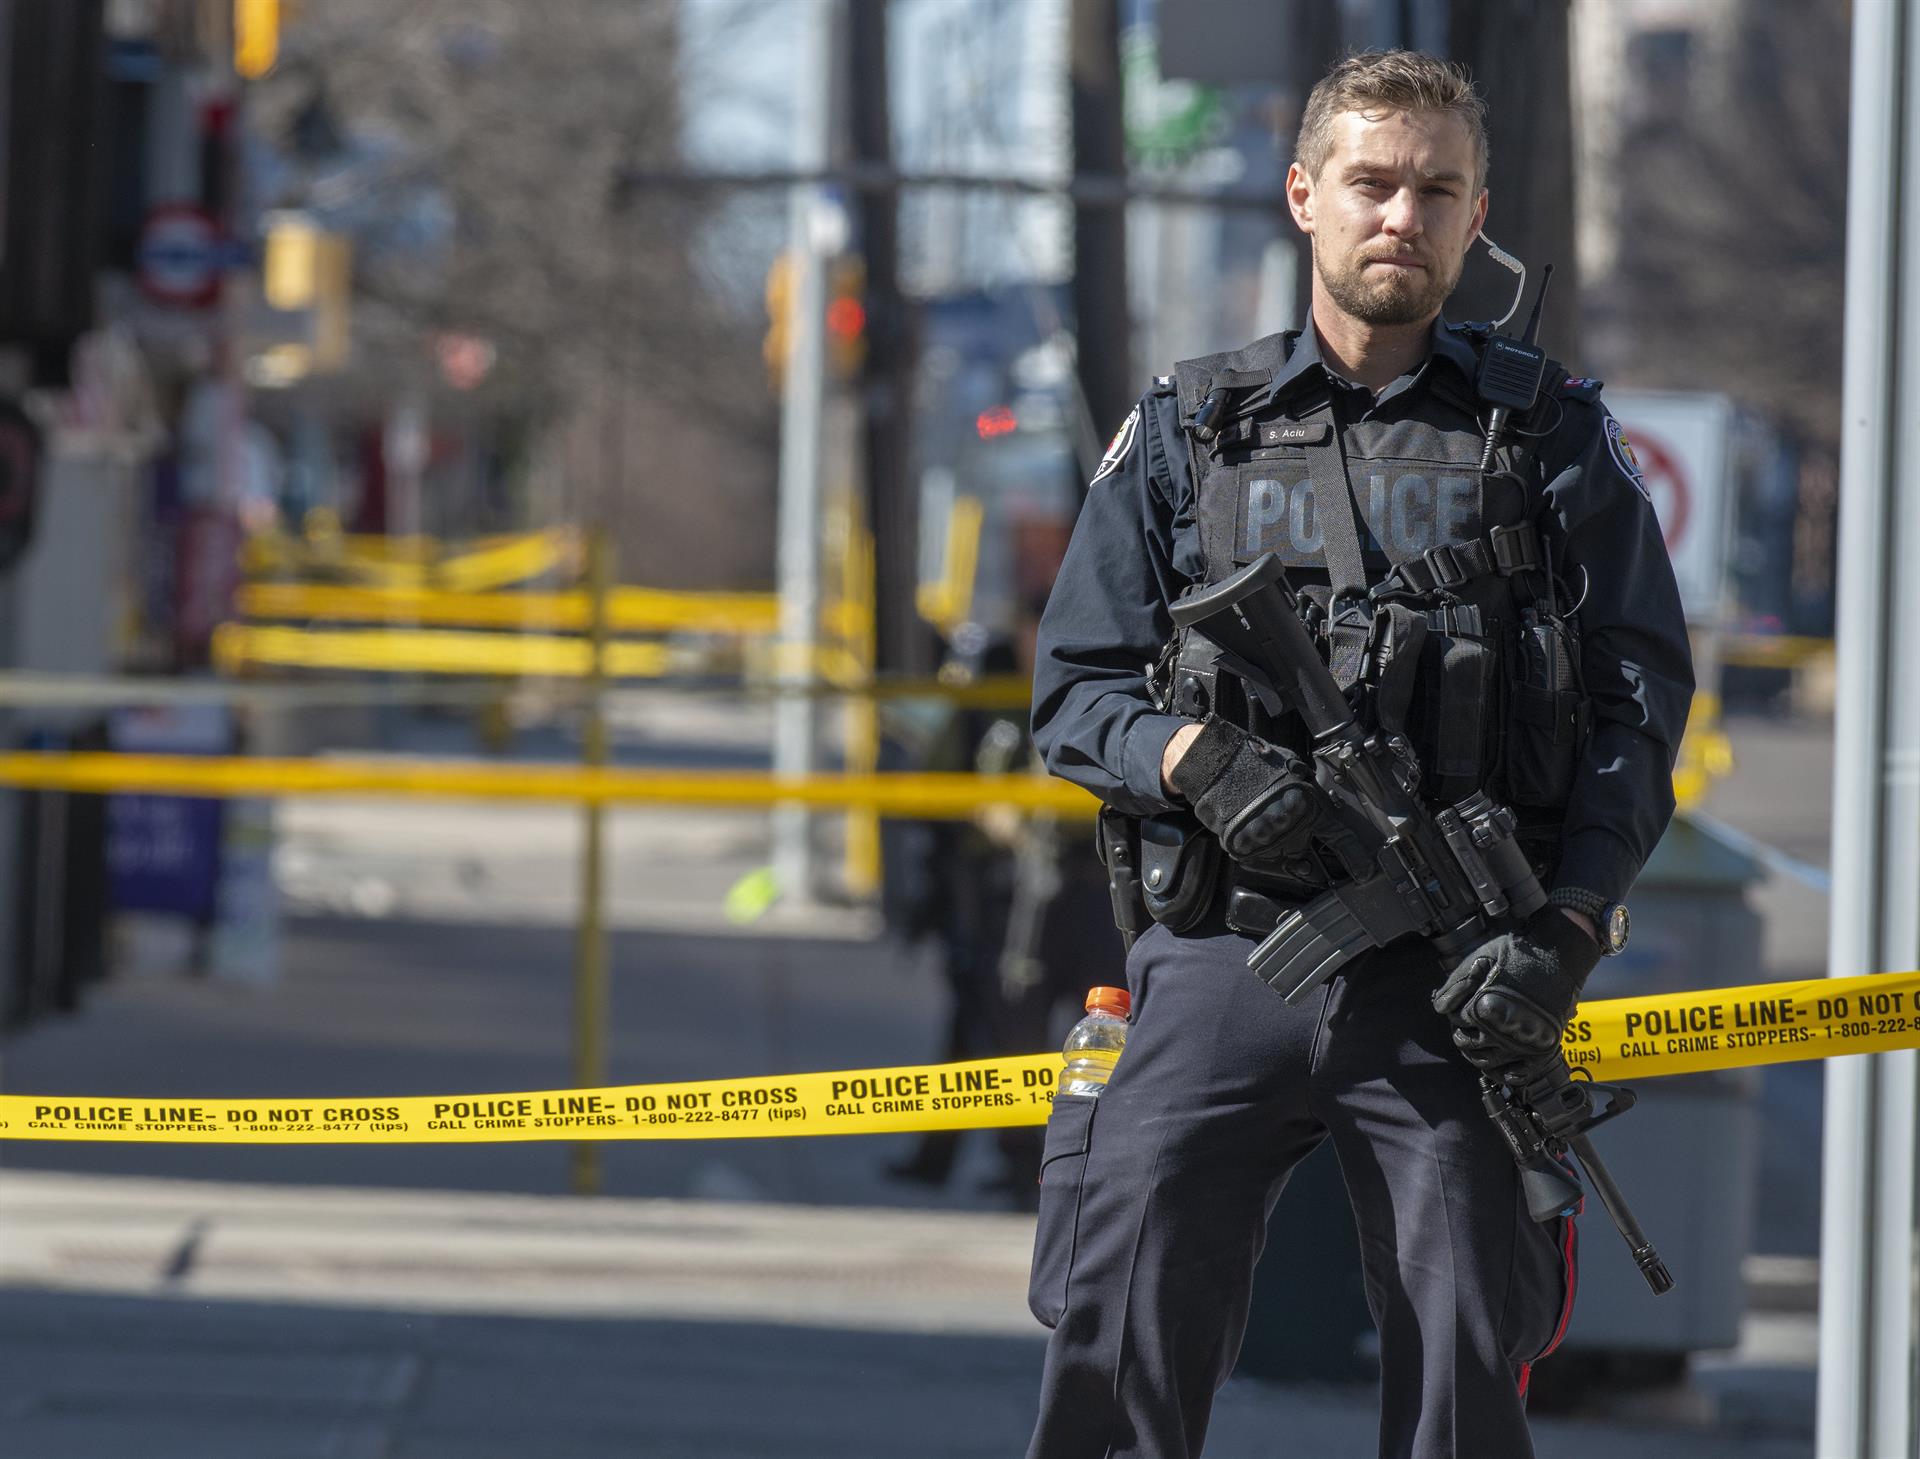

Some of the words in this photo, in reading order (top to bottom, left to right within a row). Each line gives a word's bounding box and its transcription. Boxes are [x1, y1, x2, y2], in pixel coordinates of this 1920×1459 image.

[1504, 345, 1539, 359] MOTOROLA
[1269, 430, 1278, 439] S.
[1246, 473, 1472, 554] POICE
[1625, 1006, 1725, 1038] POLICE
[1733, 999, 1807, 1029] LINE-
[1816, 997, 1849, 1021] DO
[1858, 992, 1904, 1017] NOT
[1620, 1041, 1661, 1059] CALL
[1666, 1034, 1720, 1055] CRIME
[1726, 1025, 1817, 1050] STOPPERS-
[831, 1074, 930, 1101] POLICE
[939, 1068, 1013, 1094] LINE-
[1022, 1067, 1054, 1088] DO
[35, 1105, 133, 1122] POLICE
[143, 1107, 217, 1123] LINE-
[226, 1109, 258, 1123] DO
[268, 1108, 313, 1123] NOT
[323, 1106, 400, 1122] CROSS
[434, 1099, 532, 1119] POLICE
[542, 1096, 615, 1116] LINE-
[625, 1095, 657, 1112] DO
[666, 1092, 712, 1110] NOT
[721, 1086, 798, 1107] CROSS
[825, 1102, 865, 1117] CALL
[872, 1099, 925, 1114] CRIME
[931, 1092, 1021, 1111] STOPPERS-
[28, 1121, 67, 1129] CALL
[74, 1122, 127, 1131] CRIME
[135, 1123, 226, 1132] STOPPERS-
[232, 1123, 361, 1132] 1-800-222-8477
[369, 1122, 409, 1132] (tips)
[427, 1119, 467, 1130] CALL
[474, 1118, 526, 1129] CRIME
[534, 1114, 624, 1128] STOPPERS-
[632, 1108, 759, 1125] 1-800-222-8477
[767, 1106, 807, 1122] (tips)
